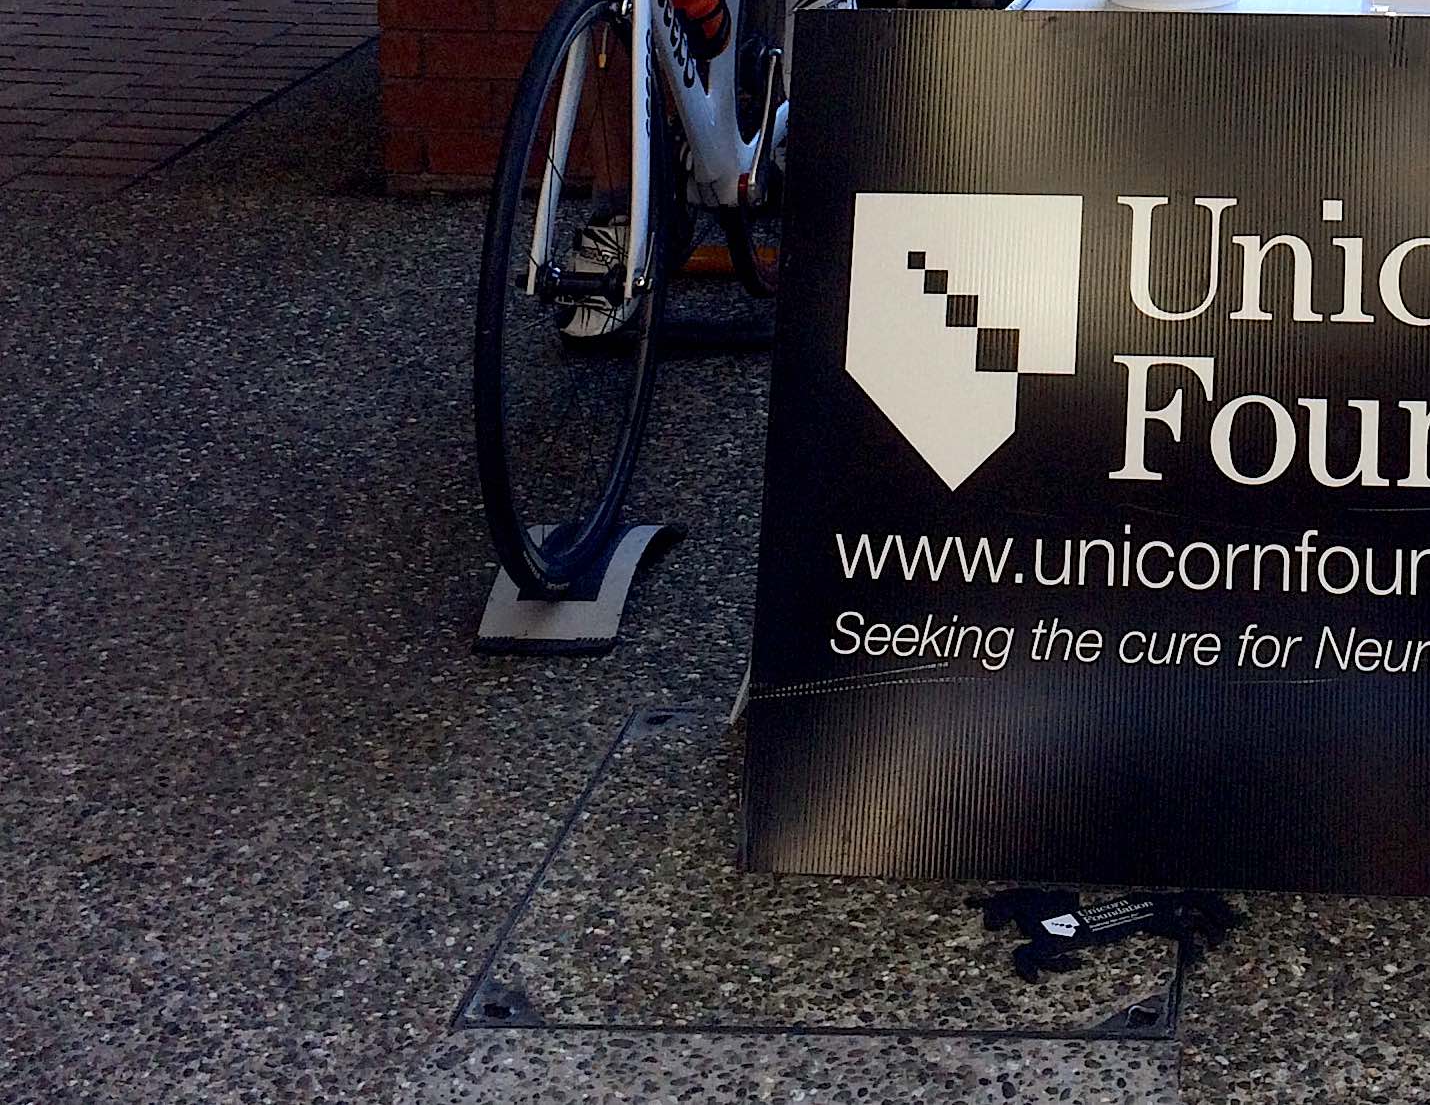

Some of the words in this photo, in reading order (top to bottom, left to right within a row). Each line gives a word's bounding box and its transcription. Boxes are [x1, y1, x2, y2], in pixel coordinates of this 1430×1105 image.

[830, 611, 1015, 671] Seeking
[1030, 617, 1102, 663] the
[1118, 628, 1221, 666] cure
[1236, 623, 1301, 668] for
[1083, 901, 1154, 924] Foundation
